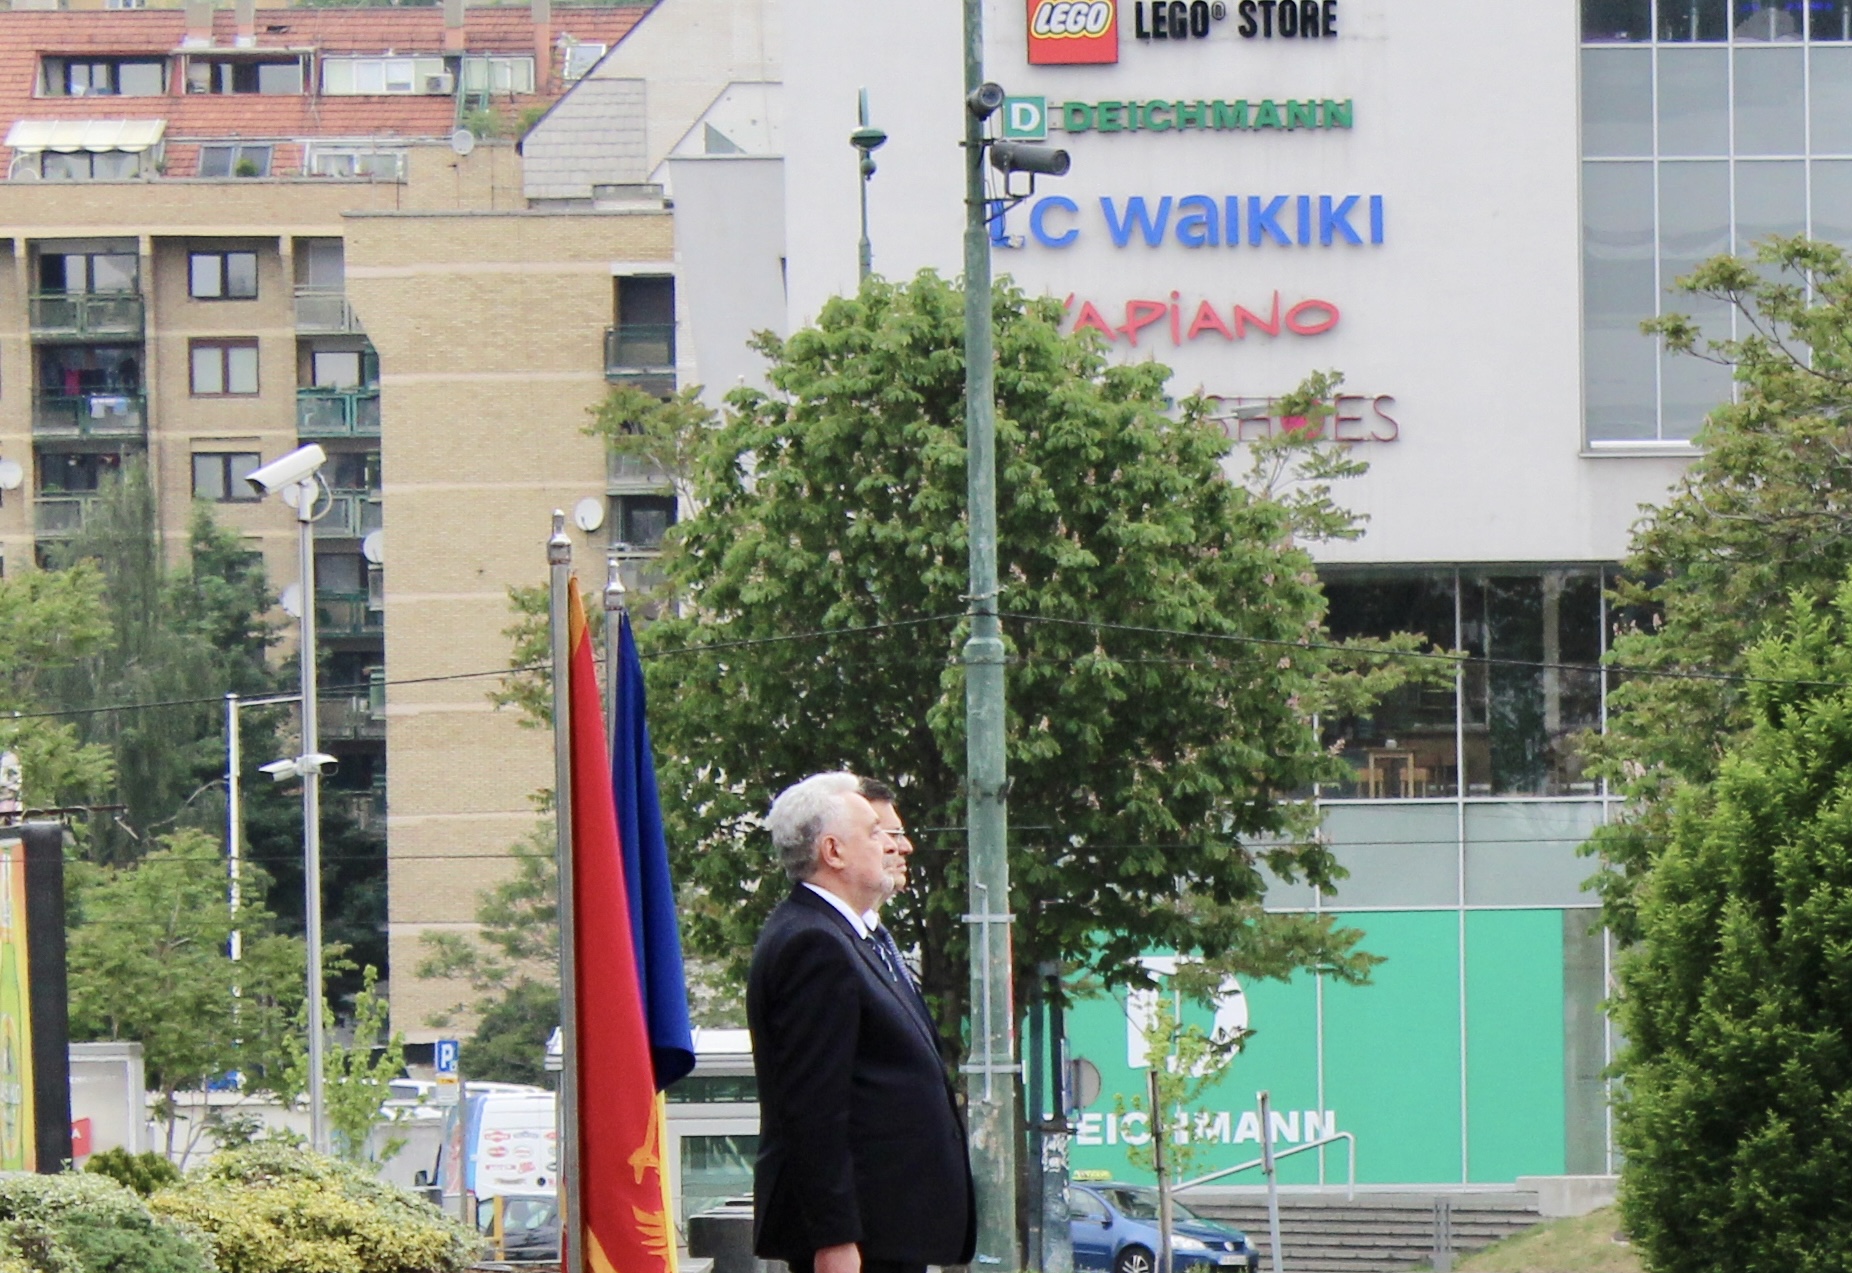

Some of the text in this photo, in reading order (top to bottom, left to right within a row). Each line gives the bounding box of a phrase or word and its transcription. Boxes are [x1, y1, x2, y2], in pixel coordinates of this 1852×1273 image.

[1034, 1, 1110, 34] LEGO
[1237, 0, 1338, 38] STORE
[1010, 102, 1041, 132] D
[1063, 99, 1354, 132] DEICHMANN
